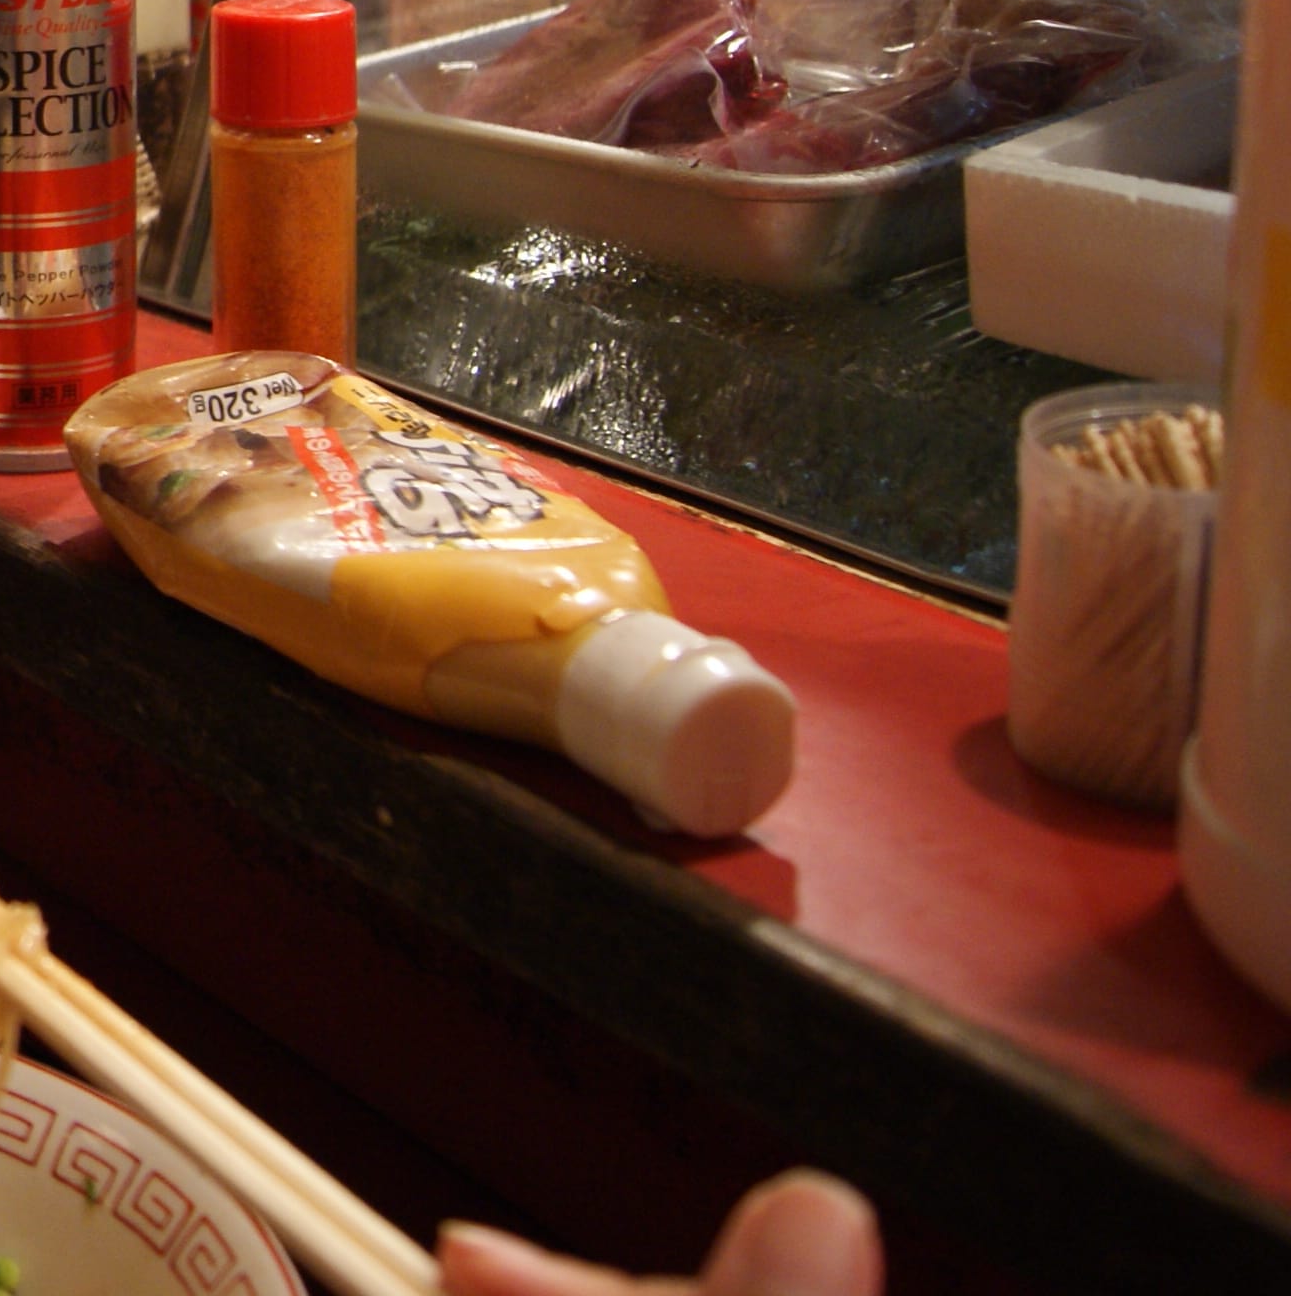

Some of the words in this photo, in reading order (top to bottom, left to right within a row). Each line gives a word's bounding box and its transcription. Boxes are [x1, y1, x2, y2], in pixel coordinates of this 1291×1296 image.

[36, 15, 102, 39] Quality
[14, 268, 74, 285] Pepper
[266, 377, 296, 400] Net
[192, 387, 261, 422] 320g
